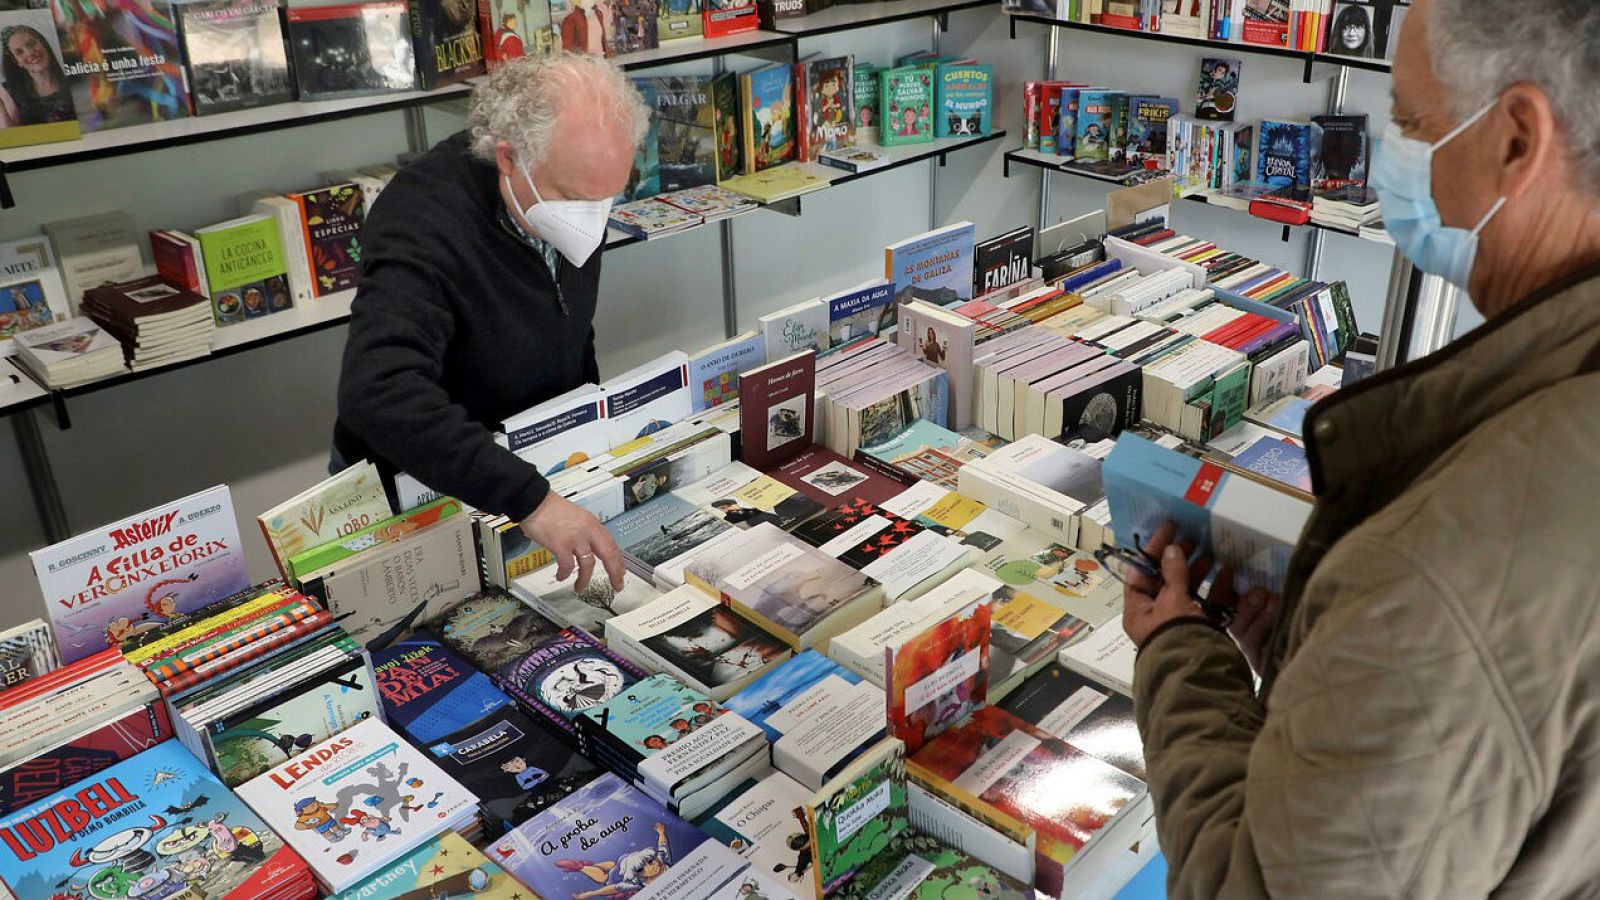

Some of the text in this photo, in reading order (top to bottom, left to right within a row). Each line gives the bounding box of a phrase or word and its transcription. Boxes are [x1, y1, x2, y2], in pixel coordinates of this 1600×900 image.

[63, 63, 99, 77] Galicia
[102, 60, 109, 71] é
[112, 58, 137, 70] unha
[139, 54, 165, 66] festa
[945, 70, 987, 82] CUENTOS
[955, 99, 987, 110] MUNDO
[1138, 108, 1169, 118] FRIKIS
[314, 222, 360, 240] ESPECIAS
[235, 239, 268, 257] COCINA
[985, 250, 1029, 296] FARIÑA
[833, 304, 840, 313] A
[109, 510, 181, 552] Astérix
[87, 565, 104, 587] A
[169, 532, 199, 553] de
[457, 729, 508, 756] CARABELA
[269, 736, 354, 791] LENDAS
[0, 777, 140, 862] LUZBELL
[77, 821, 105, 840] DEMO
[105, 800, 147, 826] BOMBILLA
[736, 797, 776, 829] O Chispas
[838, 802, 866, 826] Quokka
[560, 817, 599, 851] proba
[581, 837, 601, 852] de
[345, 858, 418, 900] artney
